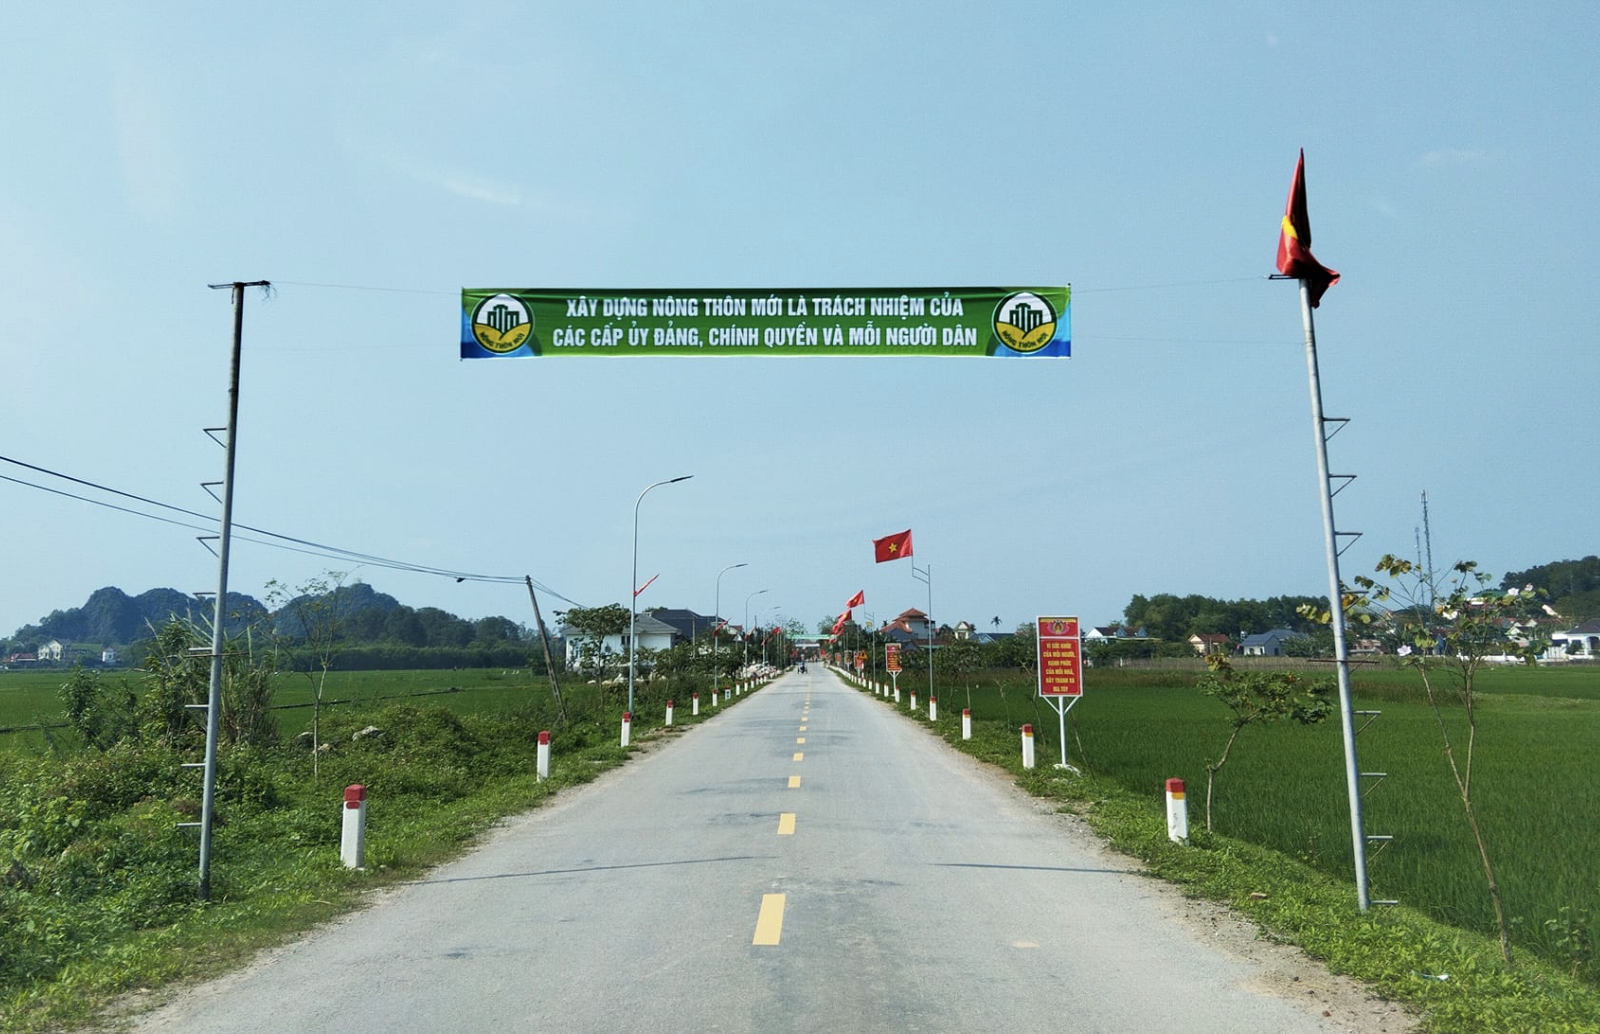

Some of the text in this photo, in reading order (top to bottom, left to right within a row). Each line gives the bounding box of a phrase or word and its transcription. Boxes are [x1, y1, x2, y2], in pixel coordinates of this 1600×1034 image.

[566, 291, 965, 320] XÂY DỰNG NÔNG THÔN MỚI LÀ TRÁCH NHIỆM CỦA
[552, 320, 977, 348] CÁC CẤP ỦY ĐẢNG, CHÍNH QUYỀN VÀ MỖI NGƯỜI DÂN
